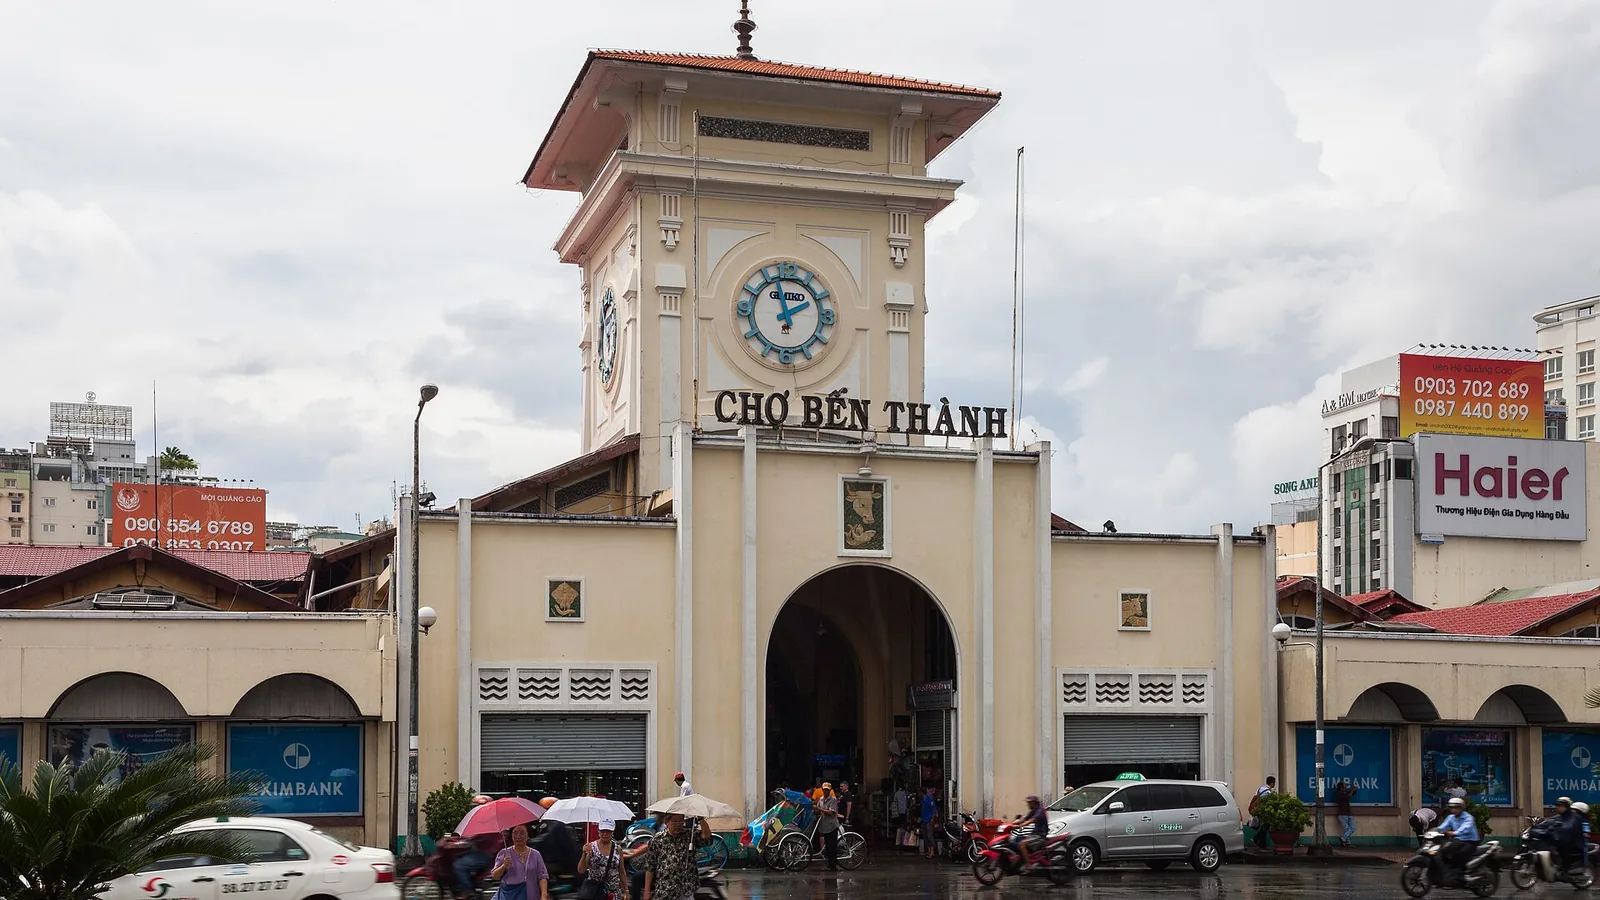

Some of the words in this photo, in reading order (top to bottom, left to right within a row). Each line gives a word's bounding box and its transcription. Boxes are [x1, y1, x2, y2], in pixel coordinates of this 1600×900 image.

[777, 263, 798, 279] 12
[737, 300, 752, 316] 9
[820, 309, 835, 325] 3
[778, 348, 793, 364] 6
[1415, 376, 1455, 395] 0903
[1462, 380, 1492, 397] 702
[1498, 382, 1529, 399] 689
[714, 389, 789, 429] CHỢ
[801, 387, 870, 431] BẾN
[883, 397, 1007, 438] THÀNH
[1415, 398, 1455, 417] 0987
[1461, 402, 1492, 420] 440
[1498, 404, 1529, 421] 899
[1435, 453, 1569, 500] Haier
[1274, 480, 1298, 494] SONG
[1435, 505, 1464, 516] Thương
[1466, 507, 1482, 516] Hiệu
[1484, 507, 1500, 517] Điện
[1502, 509, 1513, 517] Gia
[1515, 510, 1534, 519] Dụng
[1536, 510, 1554, 520] Hàng
[1555, 510, 1570, 519] Đầu
[124, 517, 160, 532] 090
[166, 518, 201, 533] 554
[207, 520, 254, 535] 6789
[249, 781, 344, 796] XIMBANK
[1308, 777, 1379, 790] EIMBANK
[1547, 778, 1600, 791] EXIMBA
